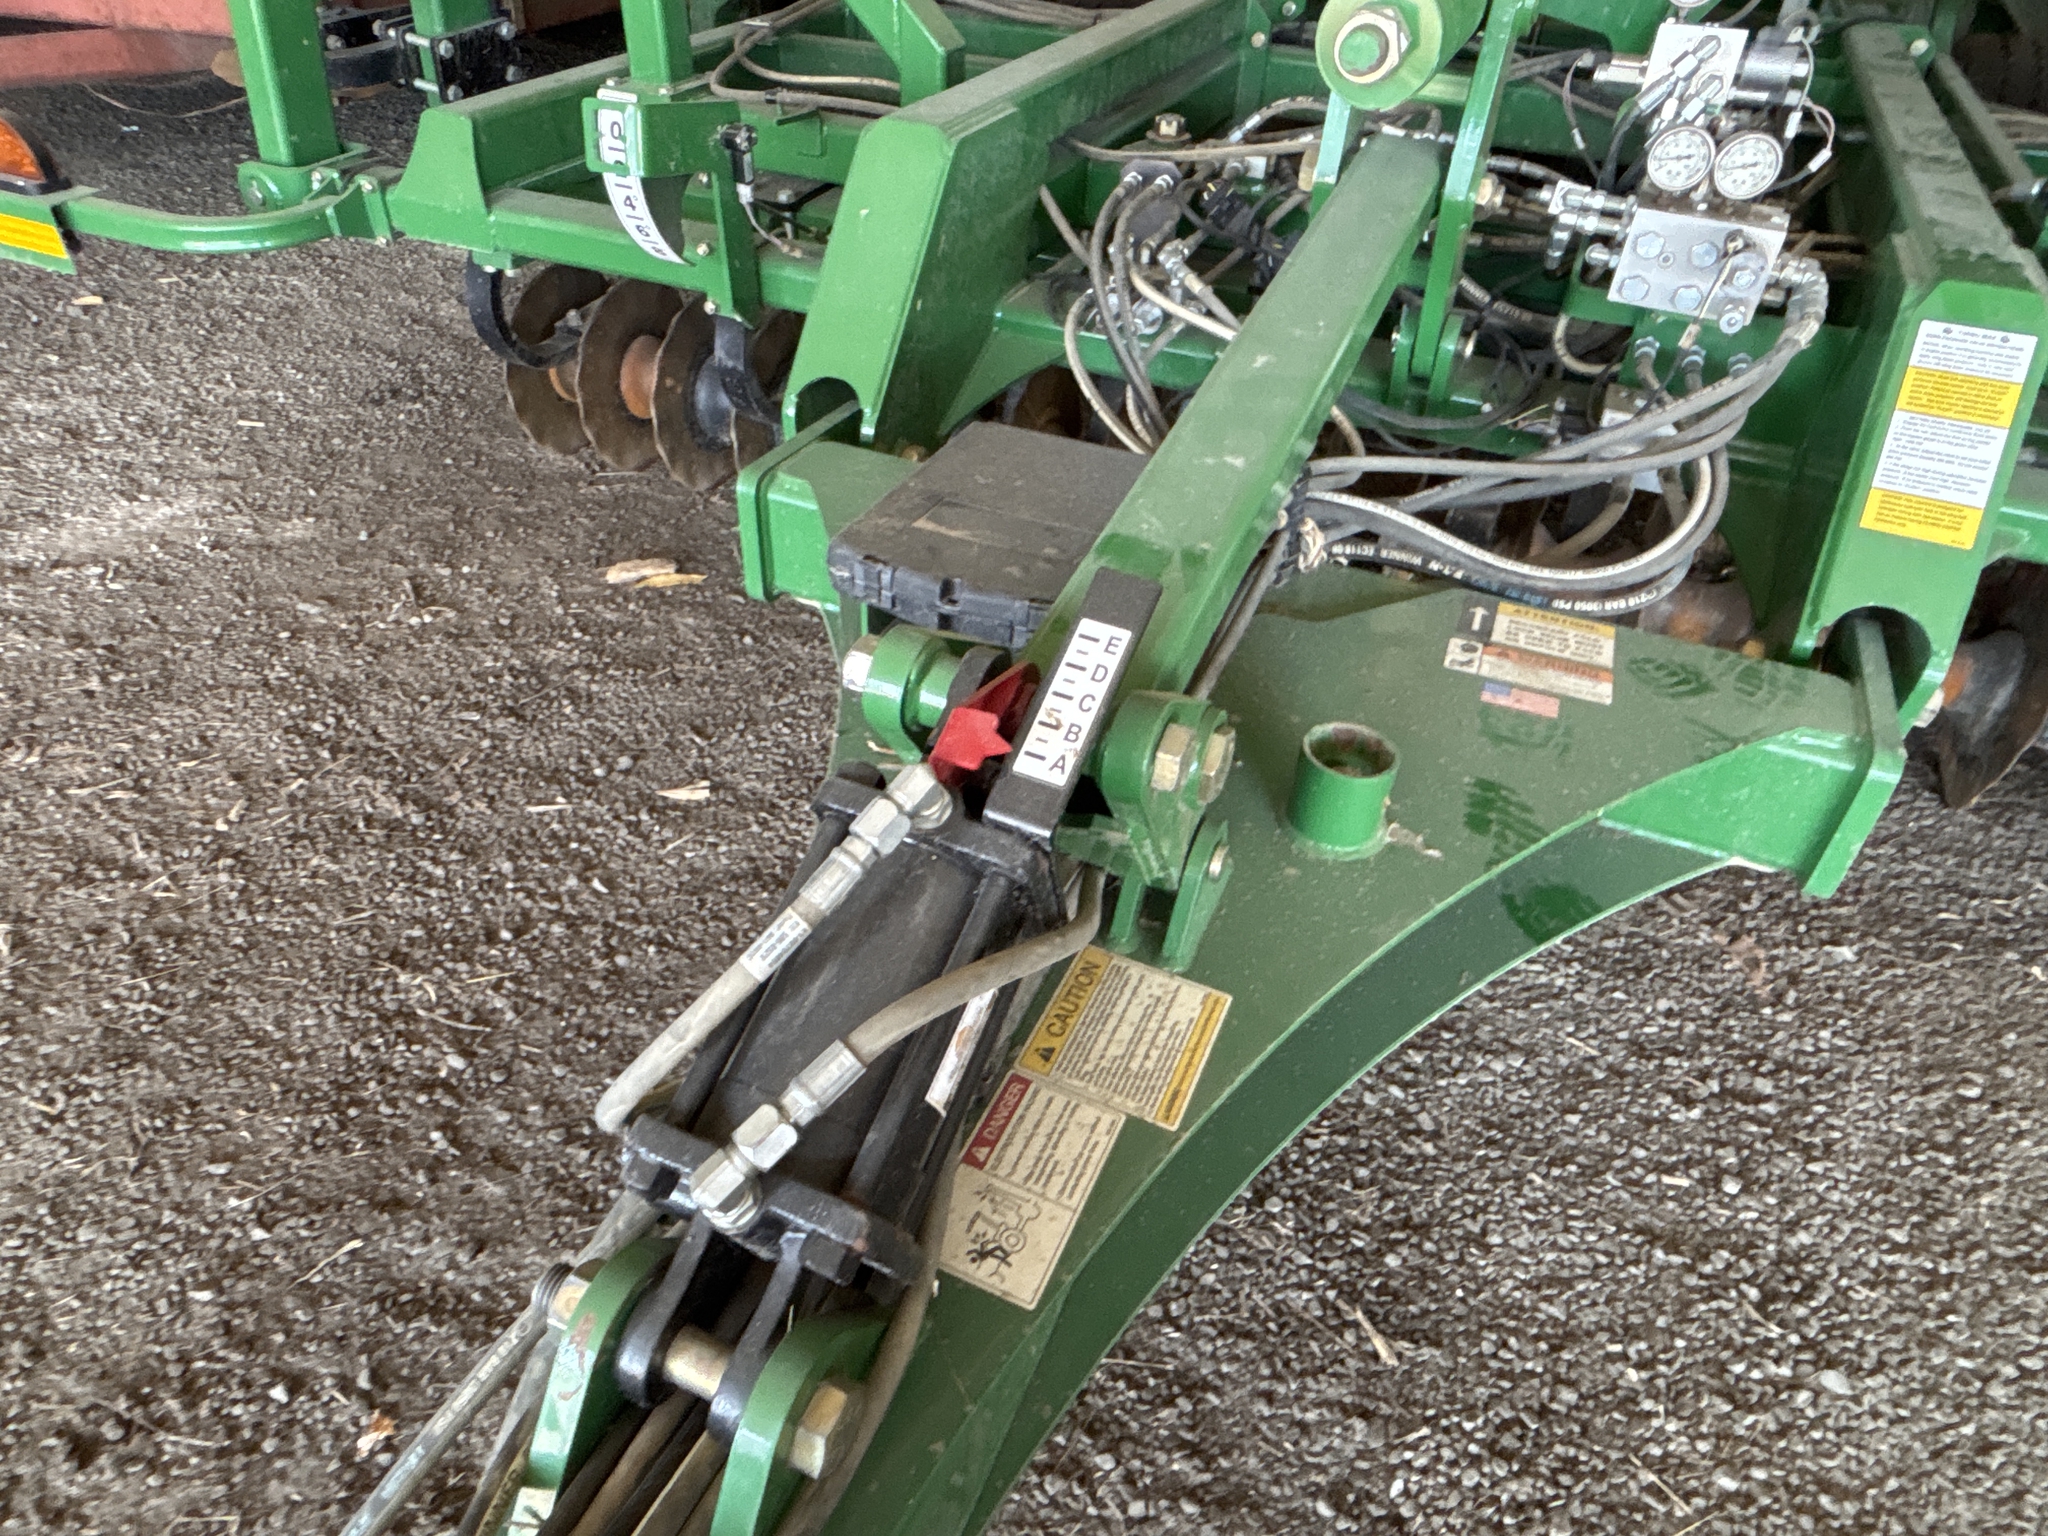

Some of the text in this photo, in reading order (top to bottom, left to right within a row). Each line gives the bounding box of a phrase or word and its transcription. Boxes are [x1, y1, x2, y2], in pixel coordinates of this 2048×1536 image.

[1603, 597, 1626, 610] BAR
[1104, 635, 1123, 655] E
[1090, 664, 1108, 683] D
[1078, 694, 1096, 713] C
[1064, 723, 1081, 743] B
[1049, 754, 1066, 775] A
[1046, 959, 1102, 1037] CAUTION
[984, 1081, 1028, 1140] DANGER
